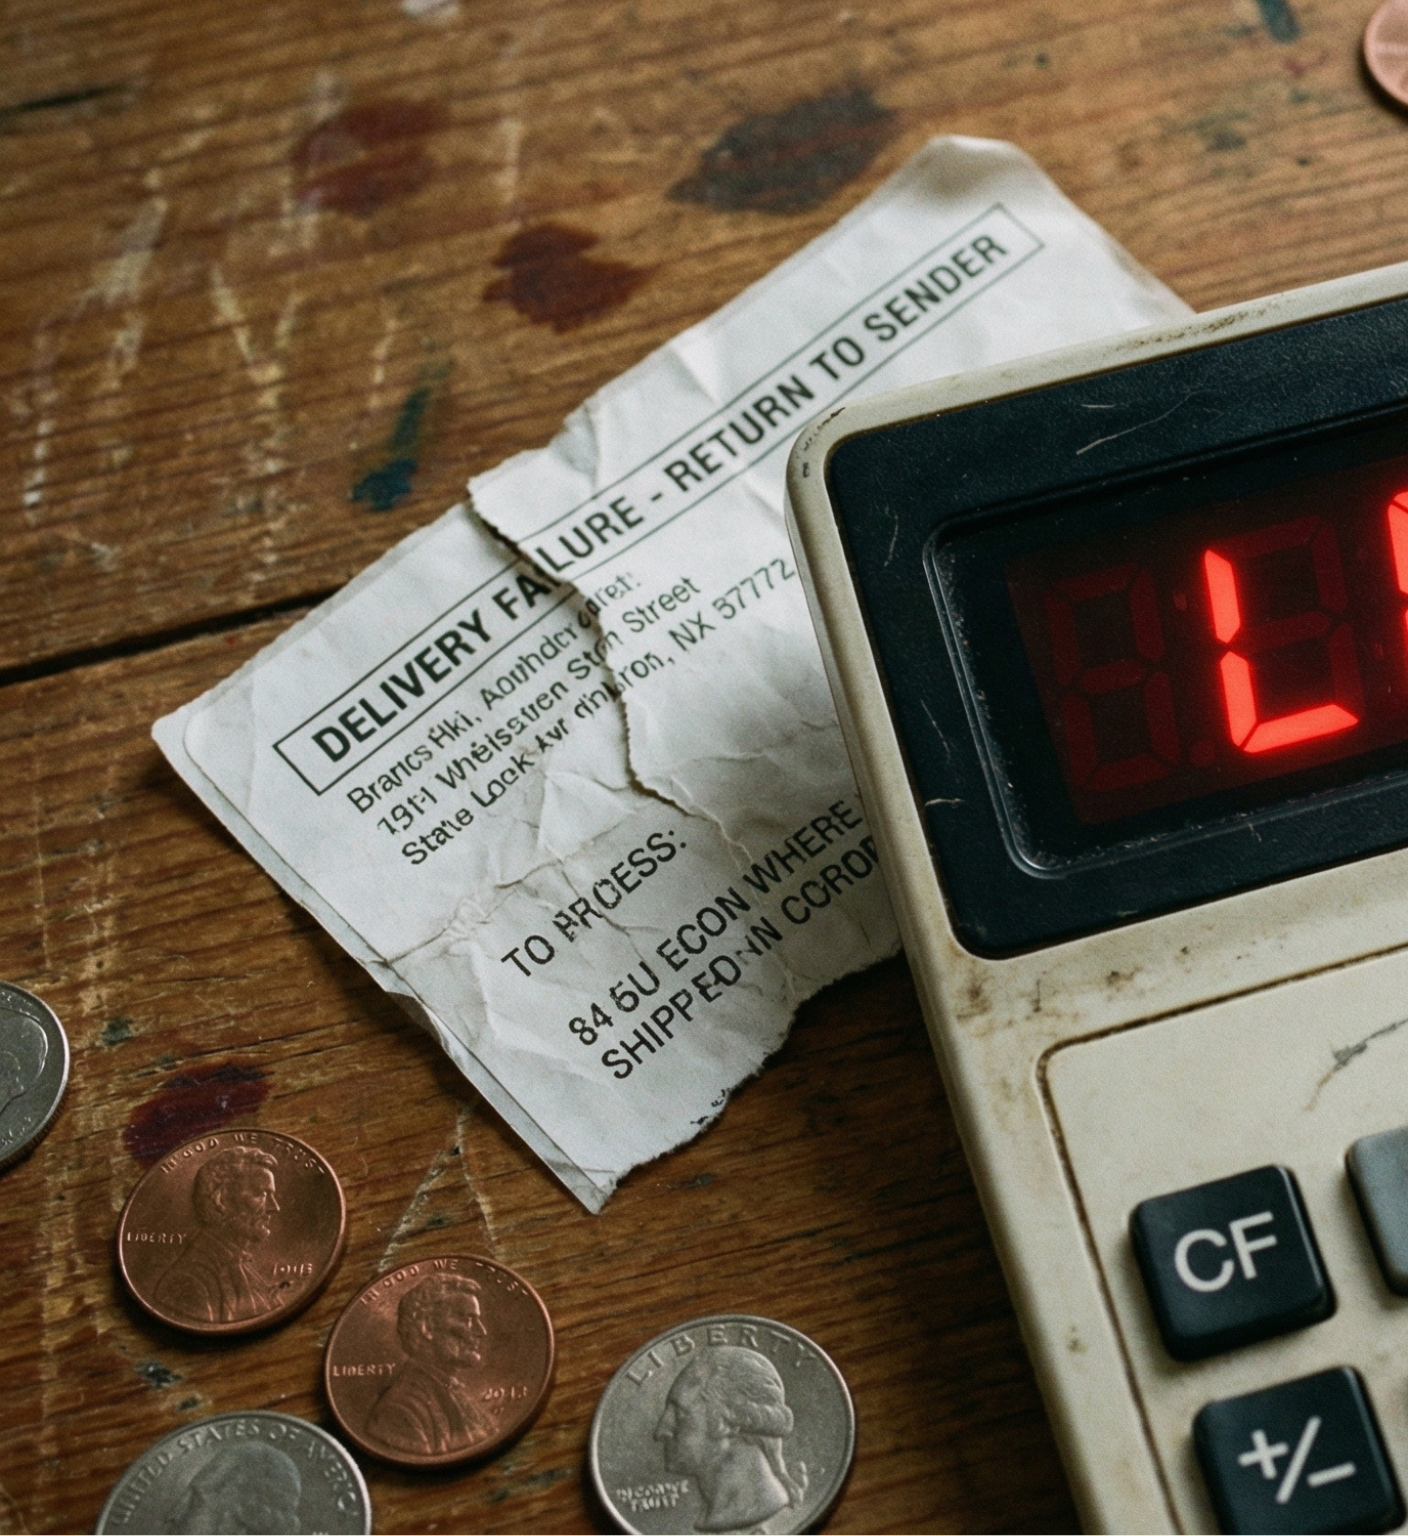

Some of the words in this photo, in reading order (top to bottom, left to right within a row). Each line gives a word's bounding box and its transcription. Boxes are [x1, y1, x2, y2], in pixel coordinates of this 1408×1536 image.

[311, 608, 491, 762] DELIVERY
[663, 374, 814, 492] RETURN
[809, 336, 865, 380] TO
[863, 236, 1006, 341] SENDER
[622, 577, 699, 632] Street
[668, 611, 715, 650] NX
[655, 886, 750, 972] ECON
[741, 799, 863, 893] WHERE
[500, 934, 555, 976] TO
[1175, 1212, 1276, 1292] CF
[626, 1325, 816, 1387] LIBERTY
